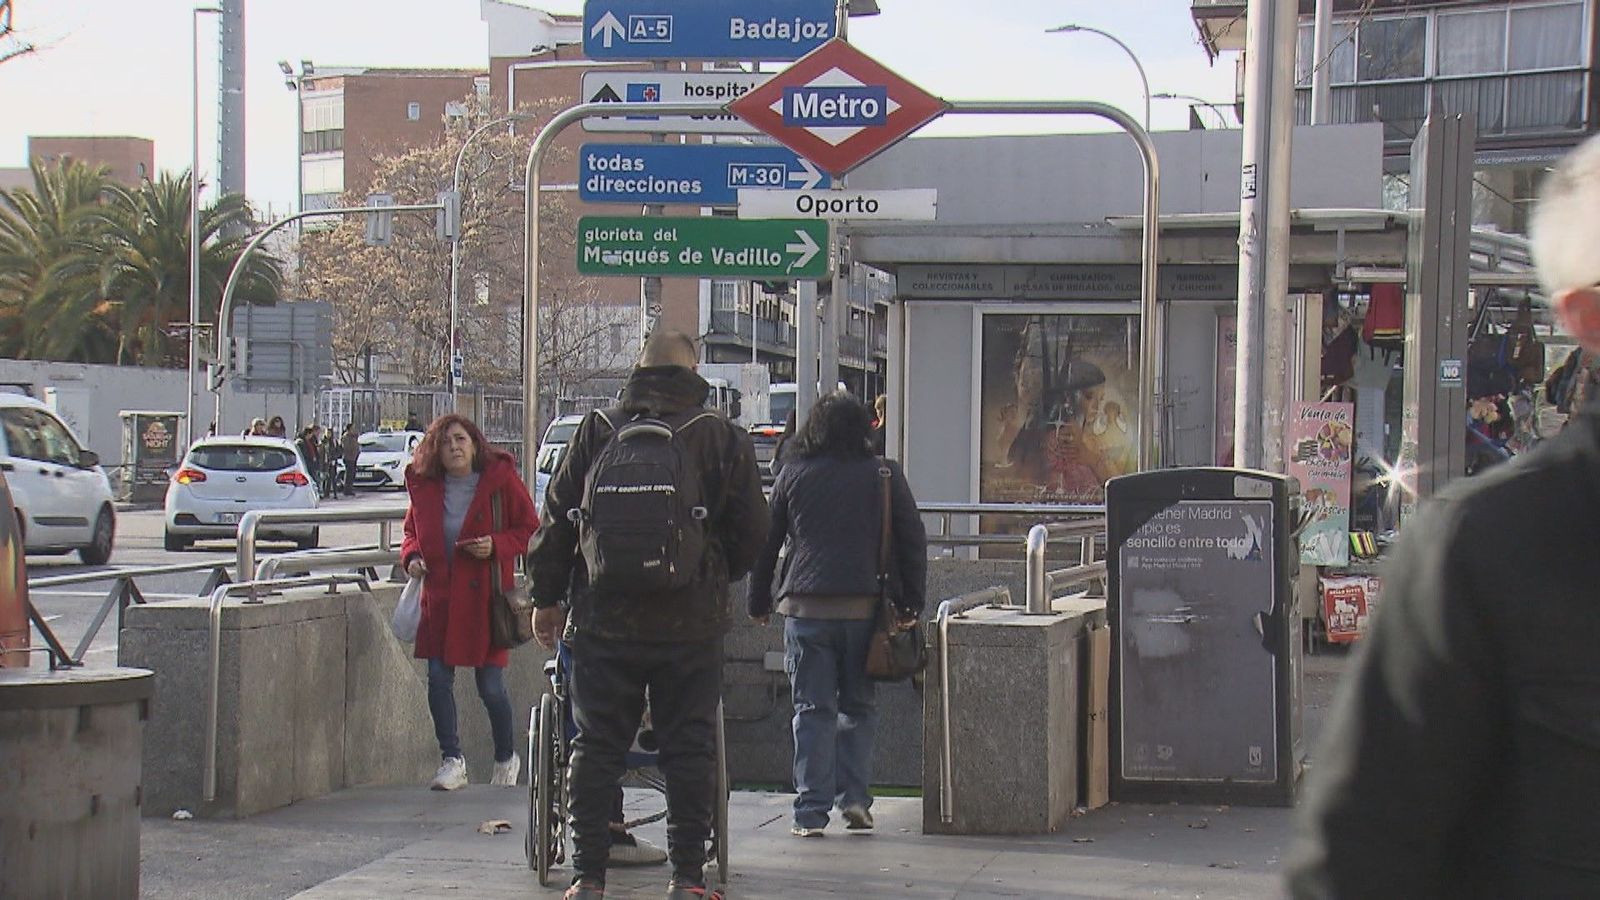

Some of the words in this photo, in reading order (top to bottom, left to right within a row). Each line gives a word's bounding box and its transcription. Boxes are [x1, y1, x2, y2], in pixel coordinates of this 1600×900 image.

[632, 20, 668, 38] A-5
[729, 18, 829, 43] Badajoz
[684, 82, 755, 99] hospita
[791, 93, 879, 119] Metro
[587, 153, 645, 171] todas
[731, 167, 782, 185] M-30
[586, 175, 702, 195] direcciones
[796, 194, 879, 217] Oporto
[584, 228, 644, 244] glorieta
[653, 228, 678, 242] del
[678, 247, 703, 264] de
[711, 247, 782, 267] Vadillo
[911, 282, 994, 292] COLECCIONABLES
[1443, 366, 1459, 378] NO
[1301, 406, 1332, 422] Venta
[1334, 407, 1346, 423] de
[1188, 507, 1232, 520] Madrid
[1165, 524, 1181, 534] es
[1127, 536, 1176, 548] sencillo
[1178, 537, 1214, 548] entre
[1216, 536, 1247, 549] todo
